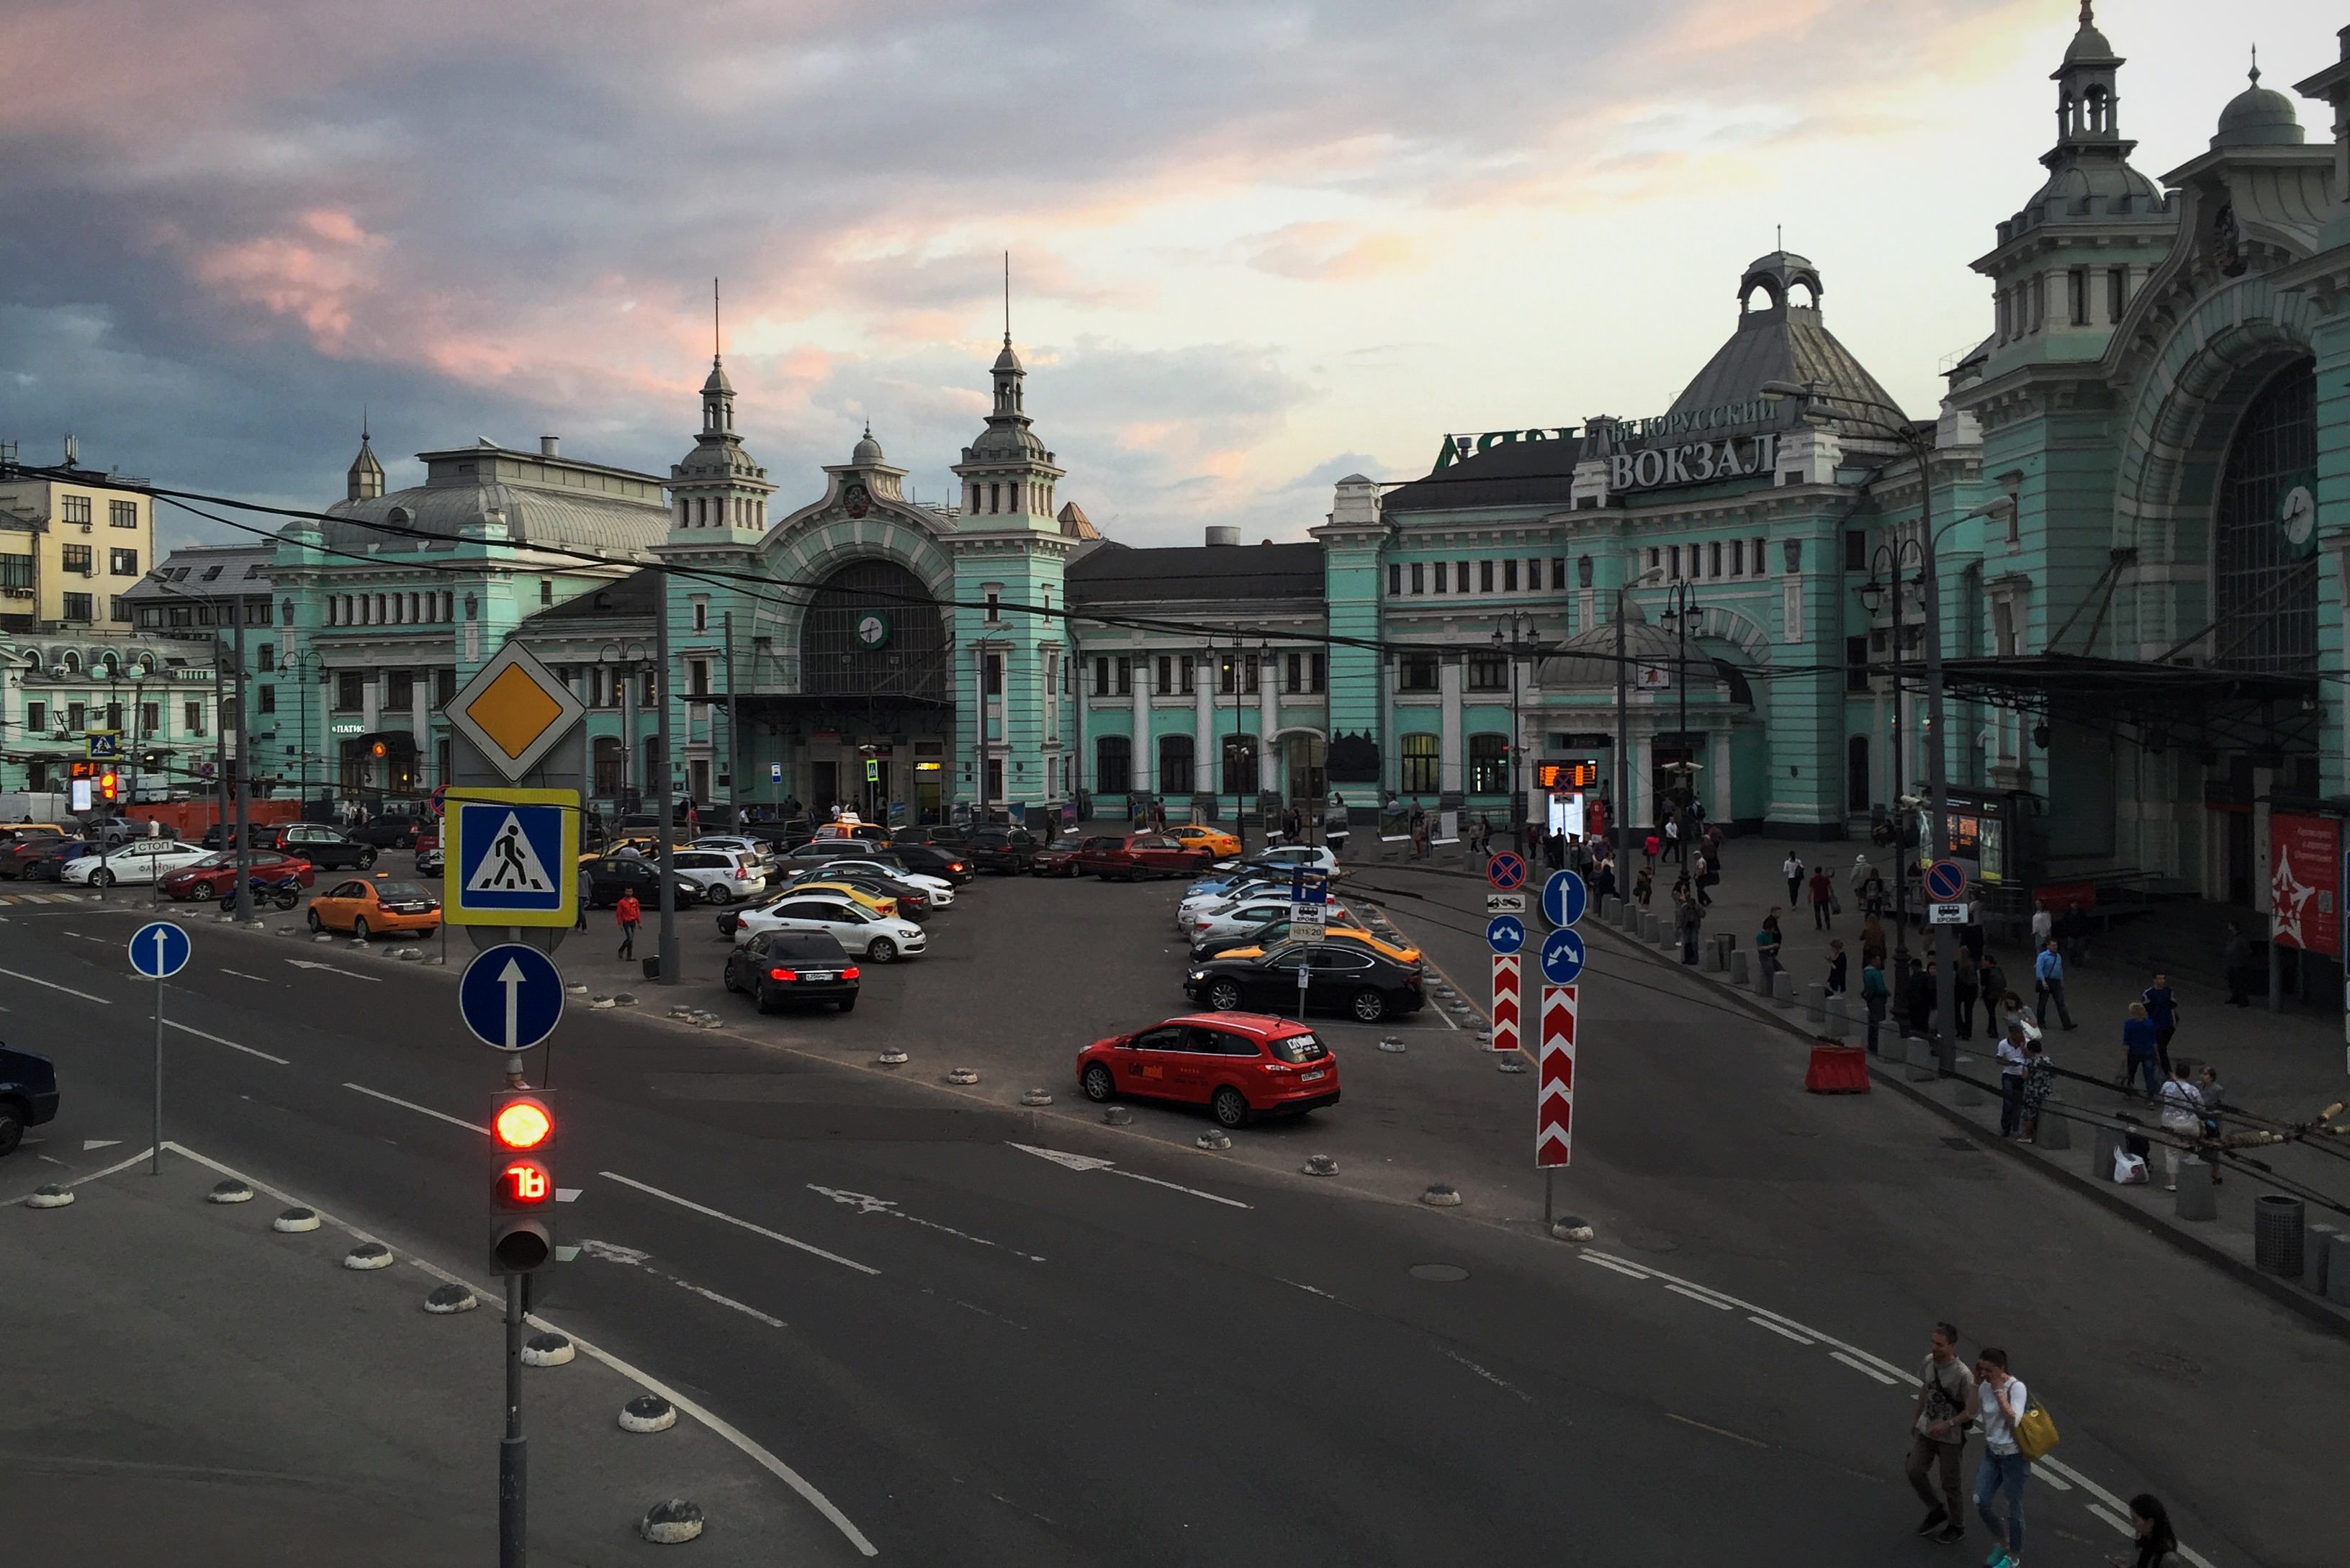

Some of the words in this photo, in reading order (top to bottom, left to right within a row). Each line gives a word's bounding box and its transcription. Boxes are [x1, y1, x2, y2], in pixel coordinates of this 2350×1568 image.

[1611, 400, 1778, 443] БЕЛОРУССКИЙ
[1610, 433, 1777, 490] ВОКЗАЛ
[138, 842, 169, 851] СТОП
